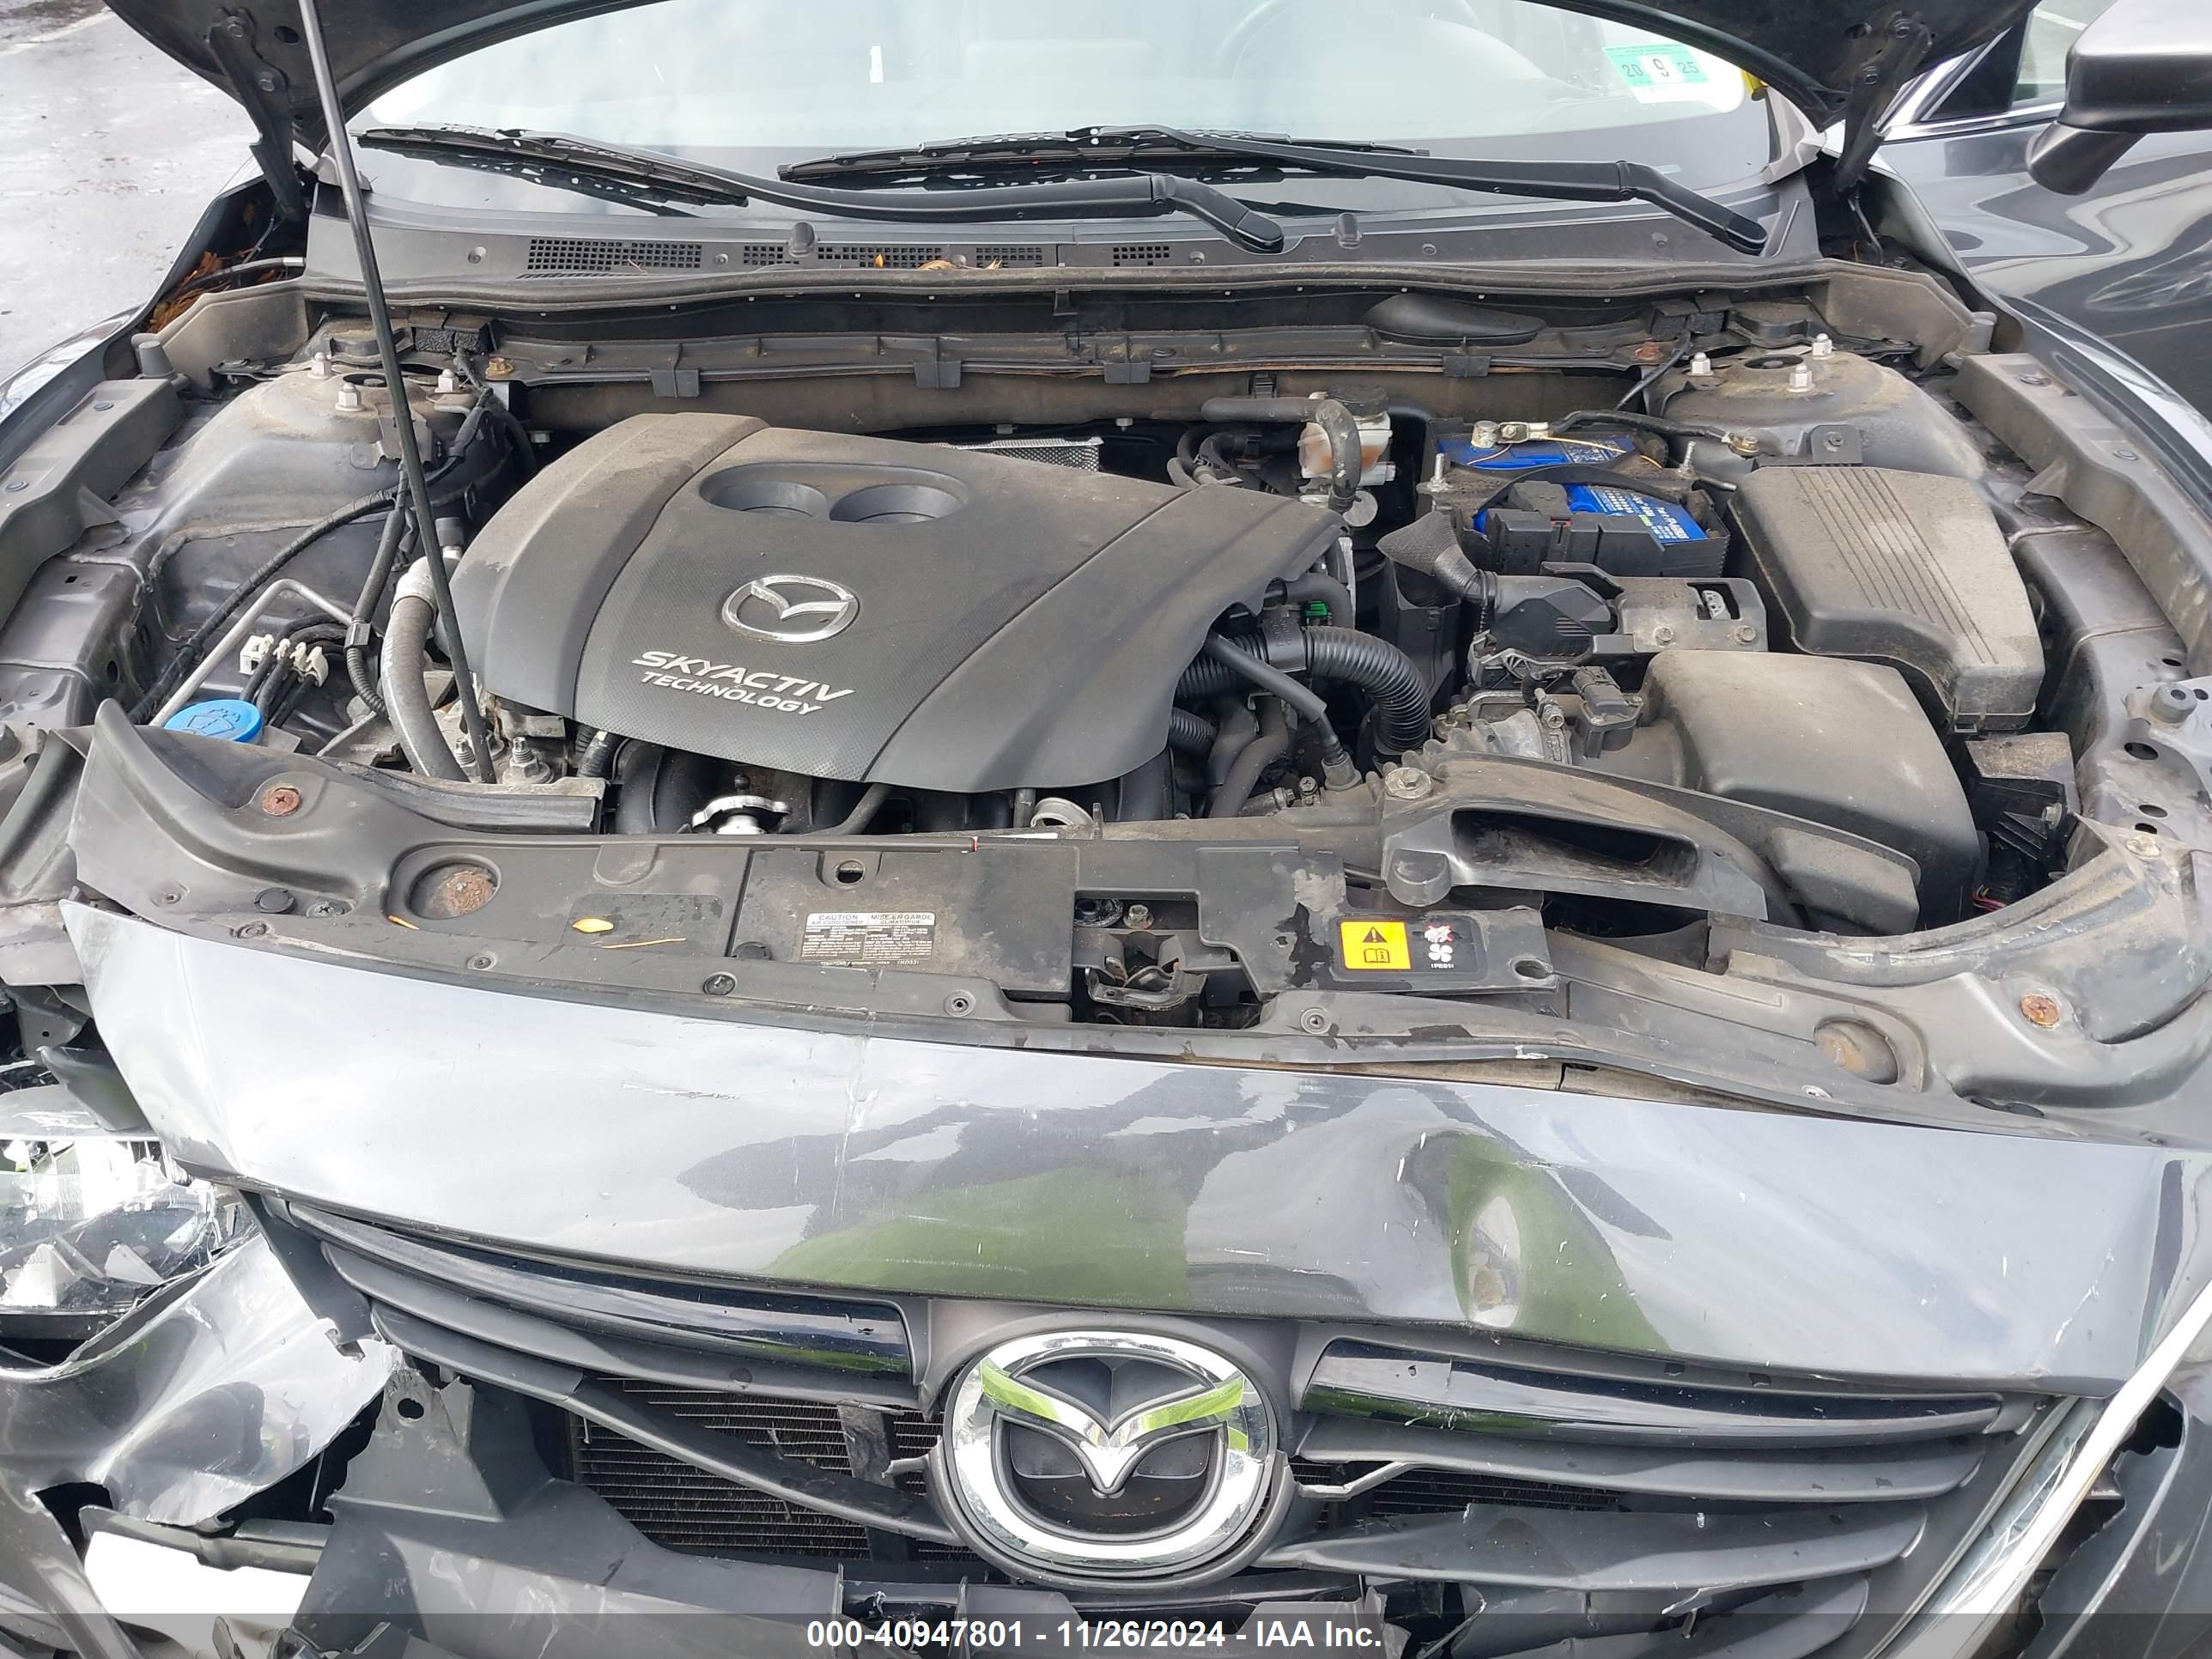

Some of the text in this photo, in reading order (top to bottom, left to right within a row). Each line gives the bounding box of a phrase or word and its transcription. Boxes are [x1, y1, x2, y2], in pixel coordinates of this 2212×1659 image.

[1622, 58, 1699, 77] 20 9 25
[631, 650, 856, 702] SKYACTIV
[641, 671, 823, 715] TECHNOLOGY
